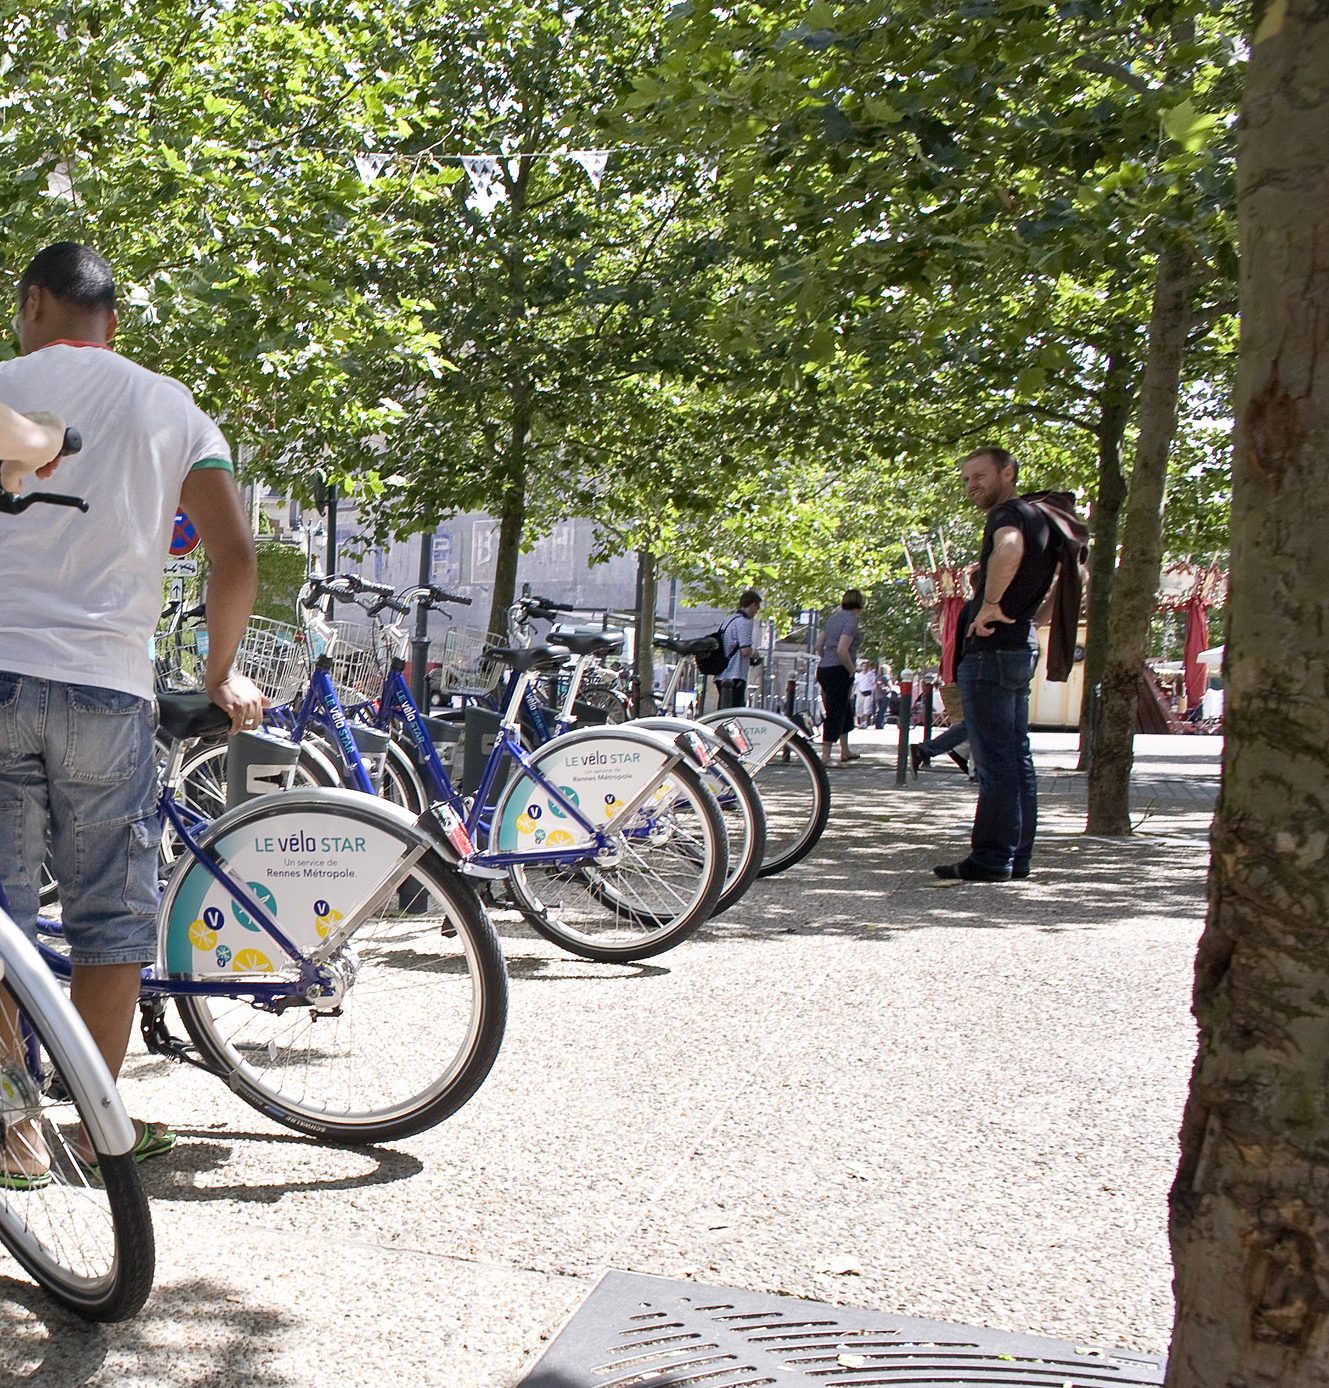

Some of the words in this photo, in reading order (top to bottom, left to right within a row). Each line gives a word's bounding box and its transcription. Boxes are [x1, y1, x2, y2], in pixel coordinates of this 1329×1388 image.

[325, 694, 336, 706] LE
[338, 729, 355, 753] STAR
[565, 756, 579, 767] LE
[581, 750, 607, 766] vélo
[610, 752, 641, 764] STAR
[255, 838, 274, 853] LE
[277, 829, 316, 853] vélo
[321, 838, 366, 853] STAR
[284, 859, 295, 867] Un
[297, 859, 325, 867] service
[327, 859, 338, 867] de
[266, 868, 301, 878] Rennes
